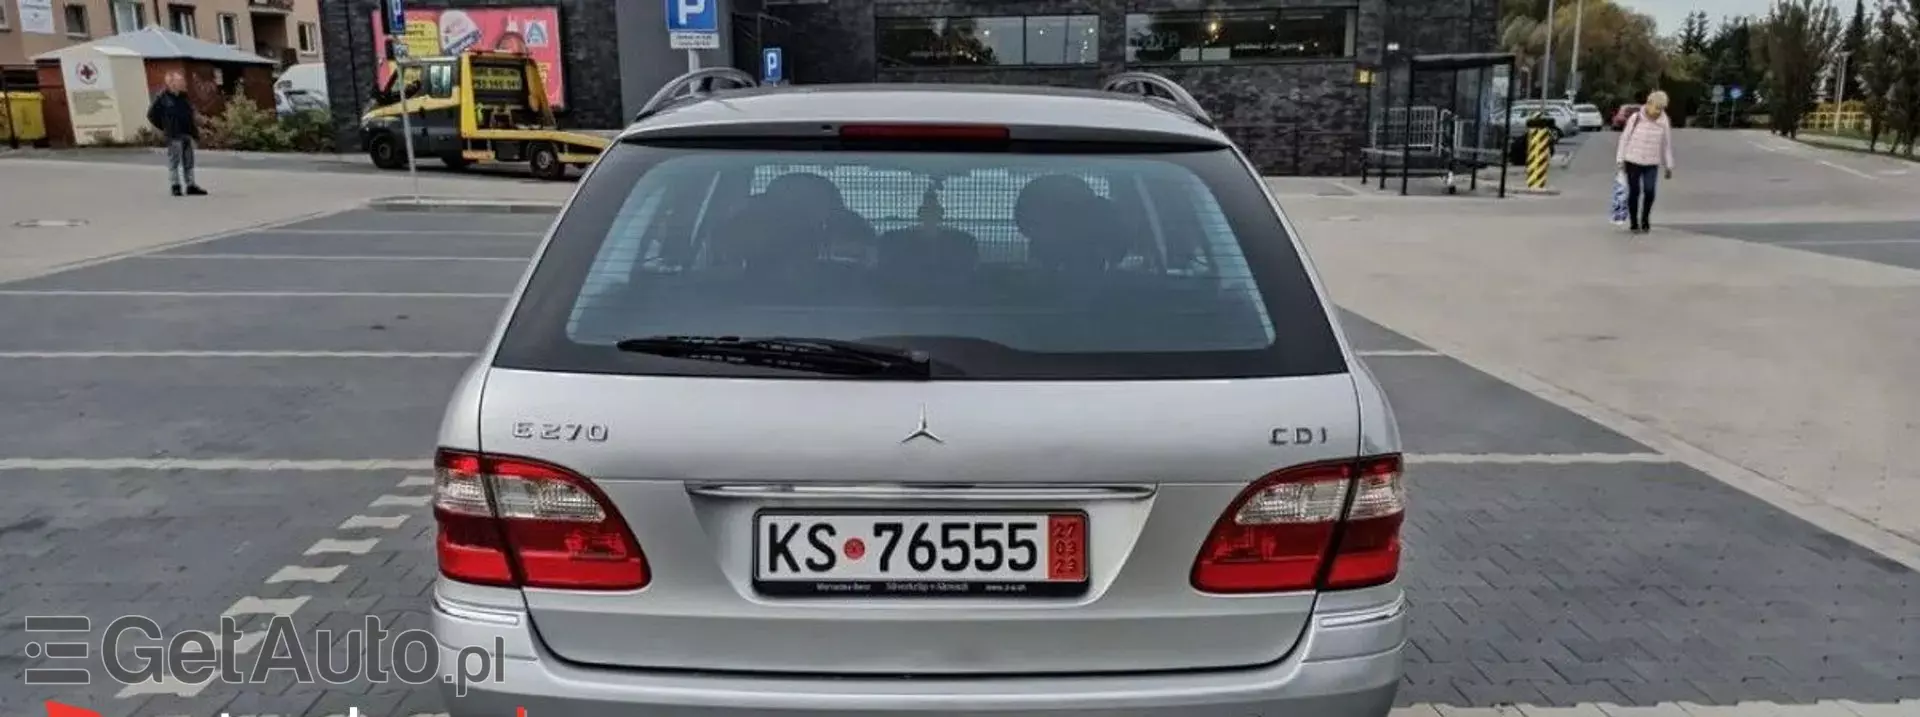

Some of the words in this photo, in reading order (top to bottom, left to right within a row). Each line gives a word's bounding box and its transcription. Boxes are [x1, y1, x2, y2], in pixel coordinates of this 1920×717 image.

[678, 0, 705, 25] P
[767, 52, 777, 76] P
[512, 421, 534, 438] E
[540, 423, 608, 441] 270
[1268, 426, 1327, 445] CDI
[768, 522, 837, 573] KS
[873, 522, 1038, 573] 76555
